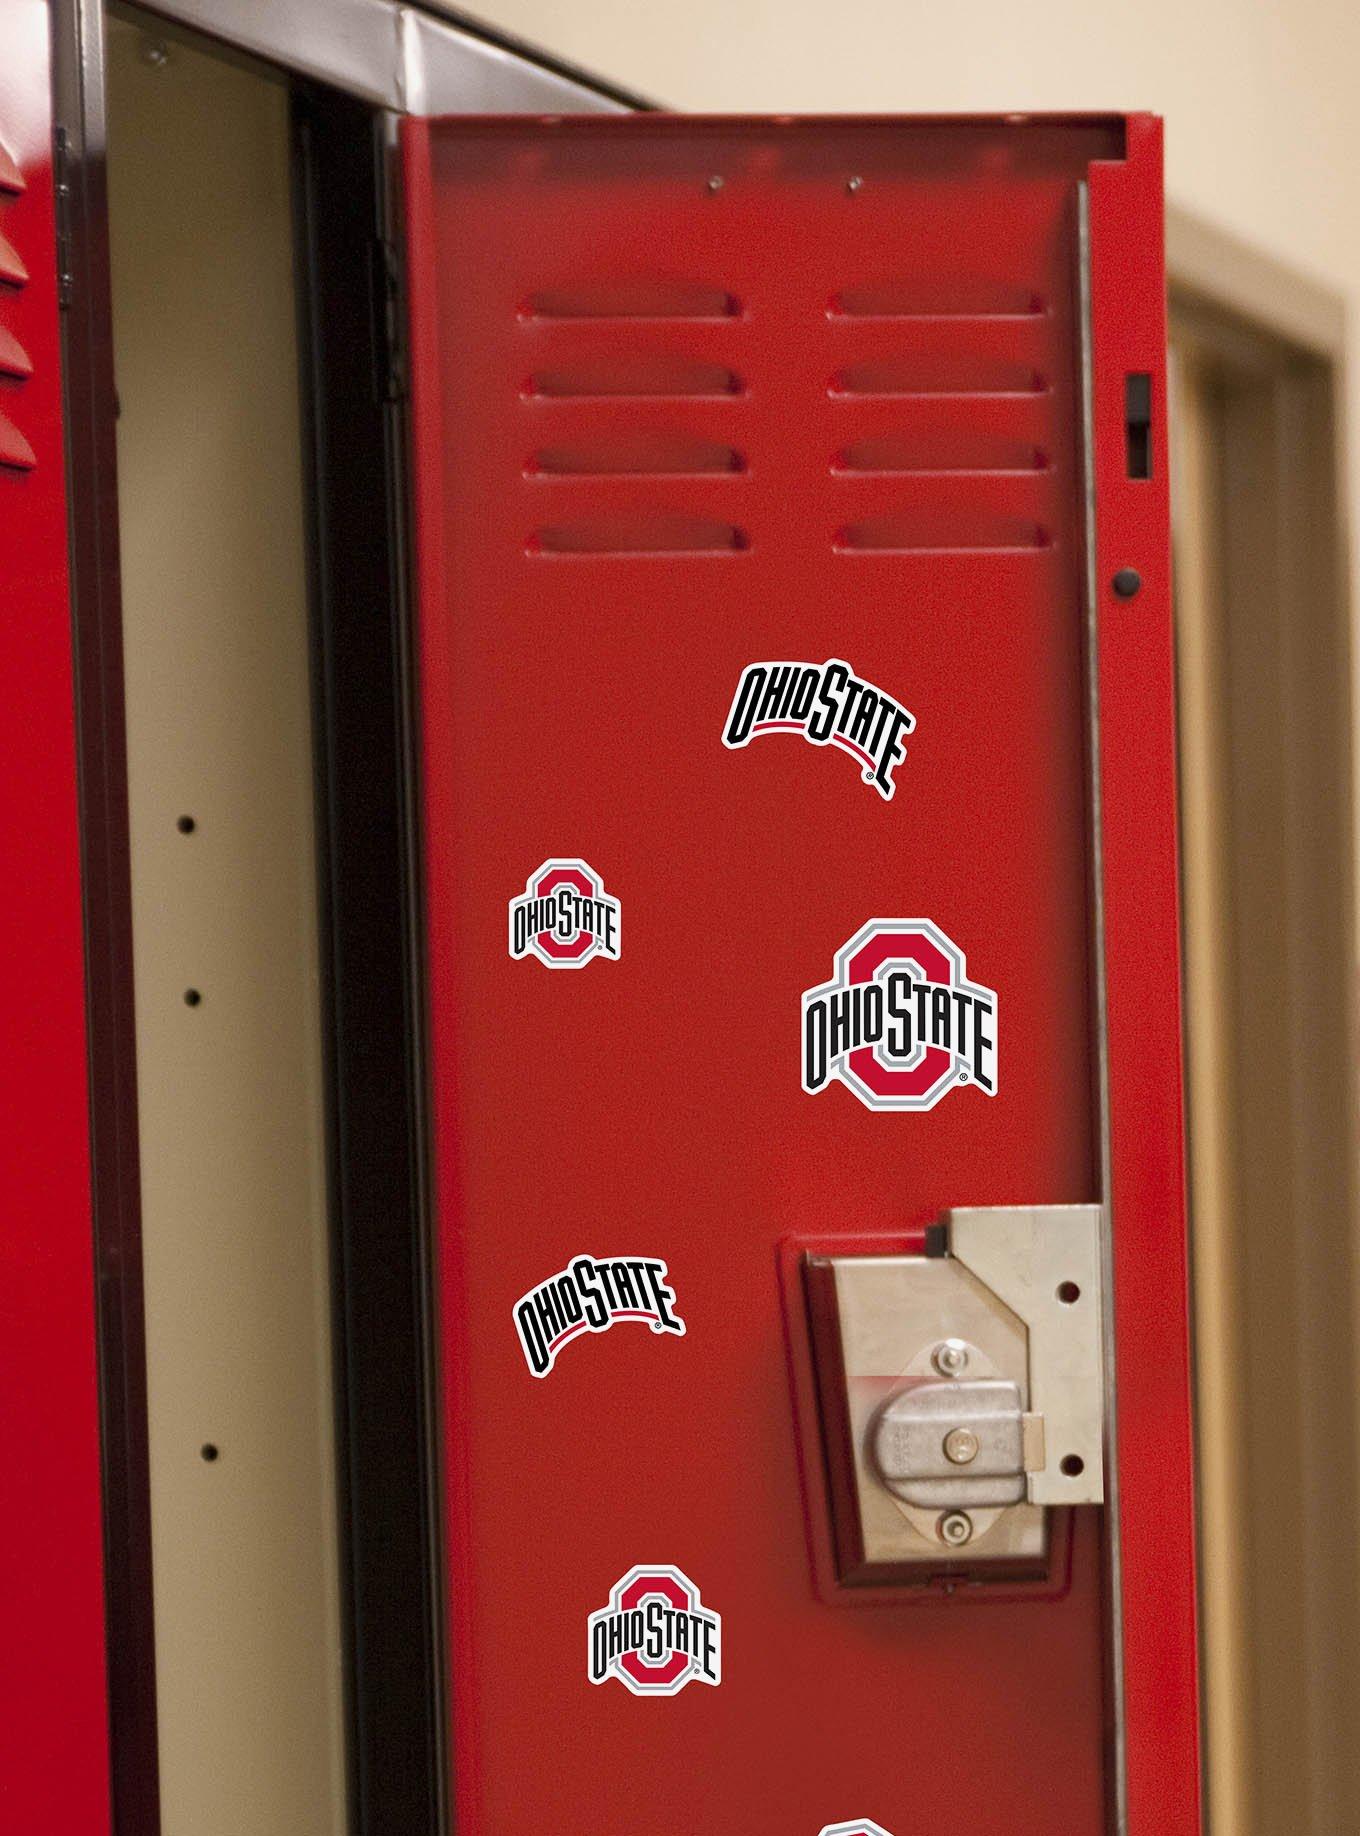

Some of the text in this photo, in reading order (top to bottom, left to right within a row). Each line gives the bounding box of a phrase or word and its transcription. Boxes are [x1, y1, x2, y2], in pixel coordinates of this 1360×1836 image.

[727, 663, 911, 795] OHIO STATE
[514, 890, 616, 955] OHIO STATE
[806, 972, 993, 1091] OHIO STATE
[518, 1259, 681, 1373] OHIO STATE
[593, 1602, 716, 1681] OHIO STATE
